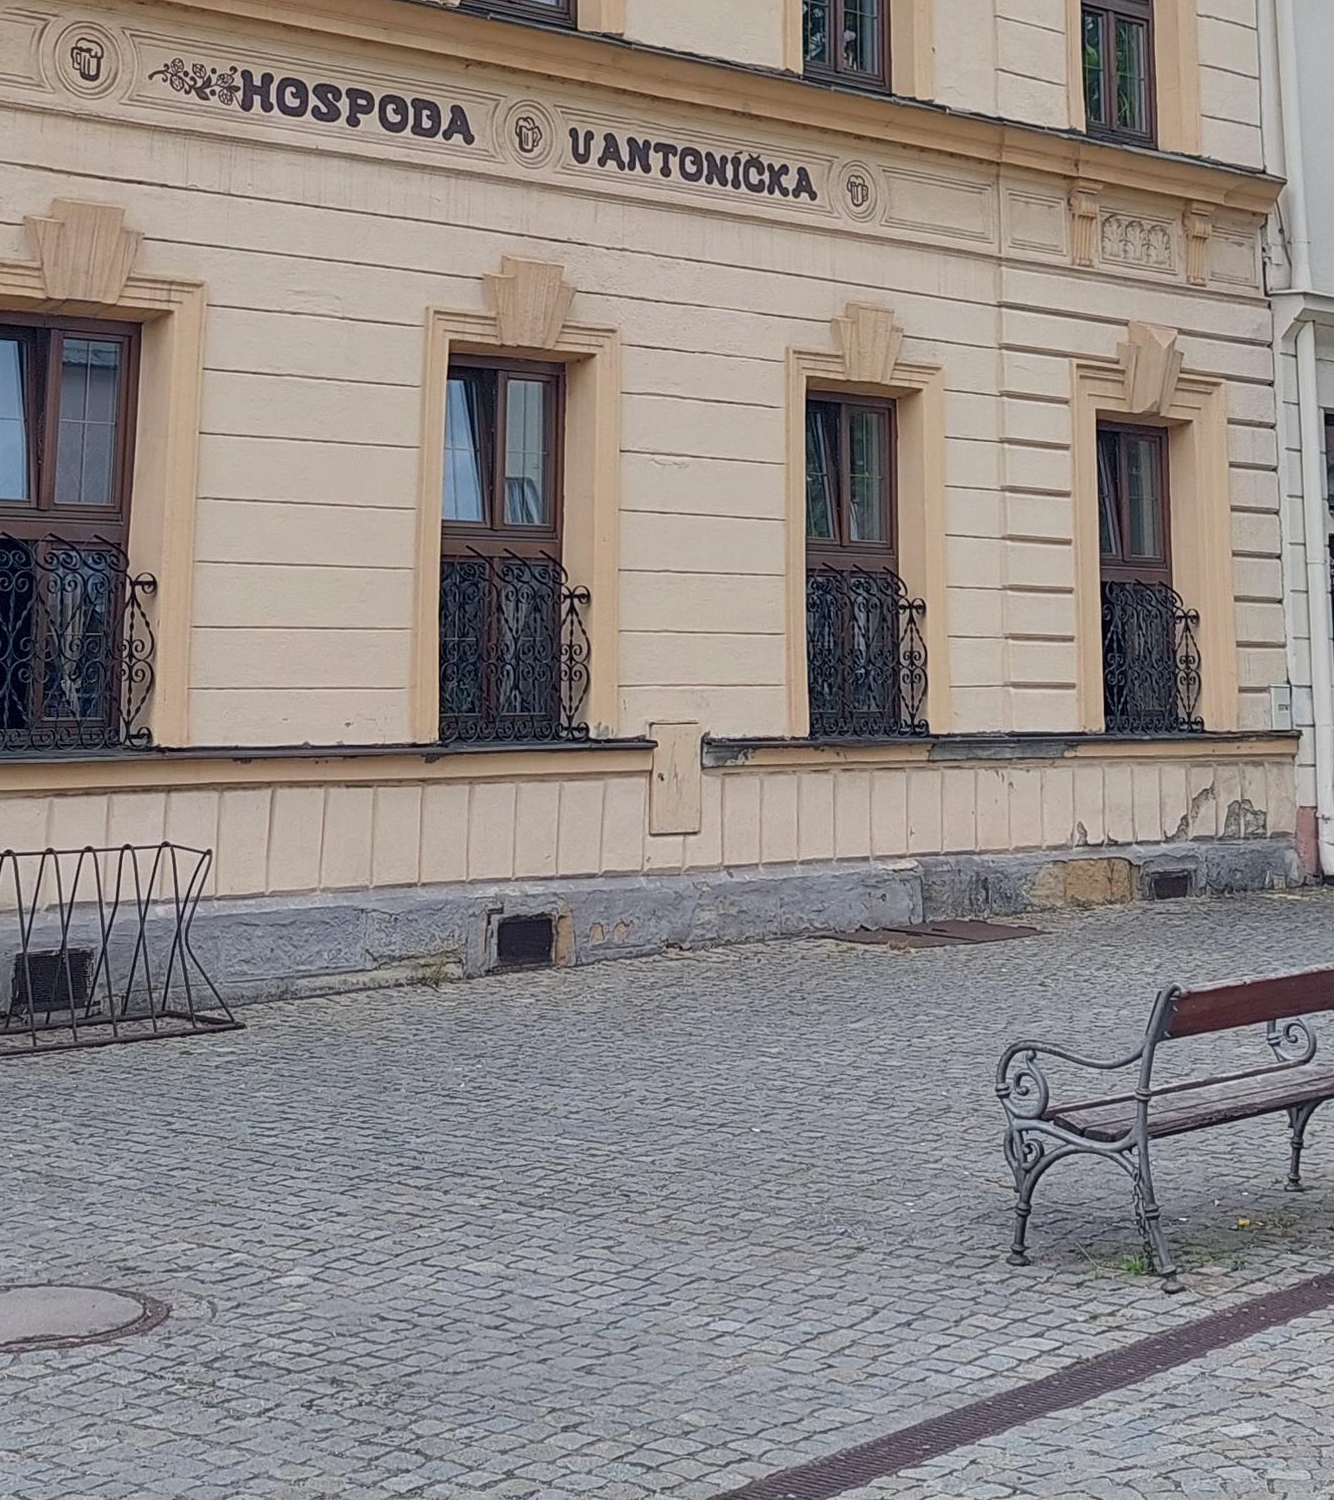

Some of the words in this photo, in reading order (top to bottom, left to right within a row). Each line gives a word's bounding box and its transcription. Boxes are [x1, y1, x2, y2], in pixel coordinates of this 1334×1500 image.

[239, 68, 475, 145] HOSPODA
[568, 127, 595, 164] U
[598, 132, 818, 201] ANTONÍČKA
